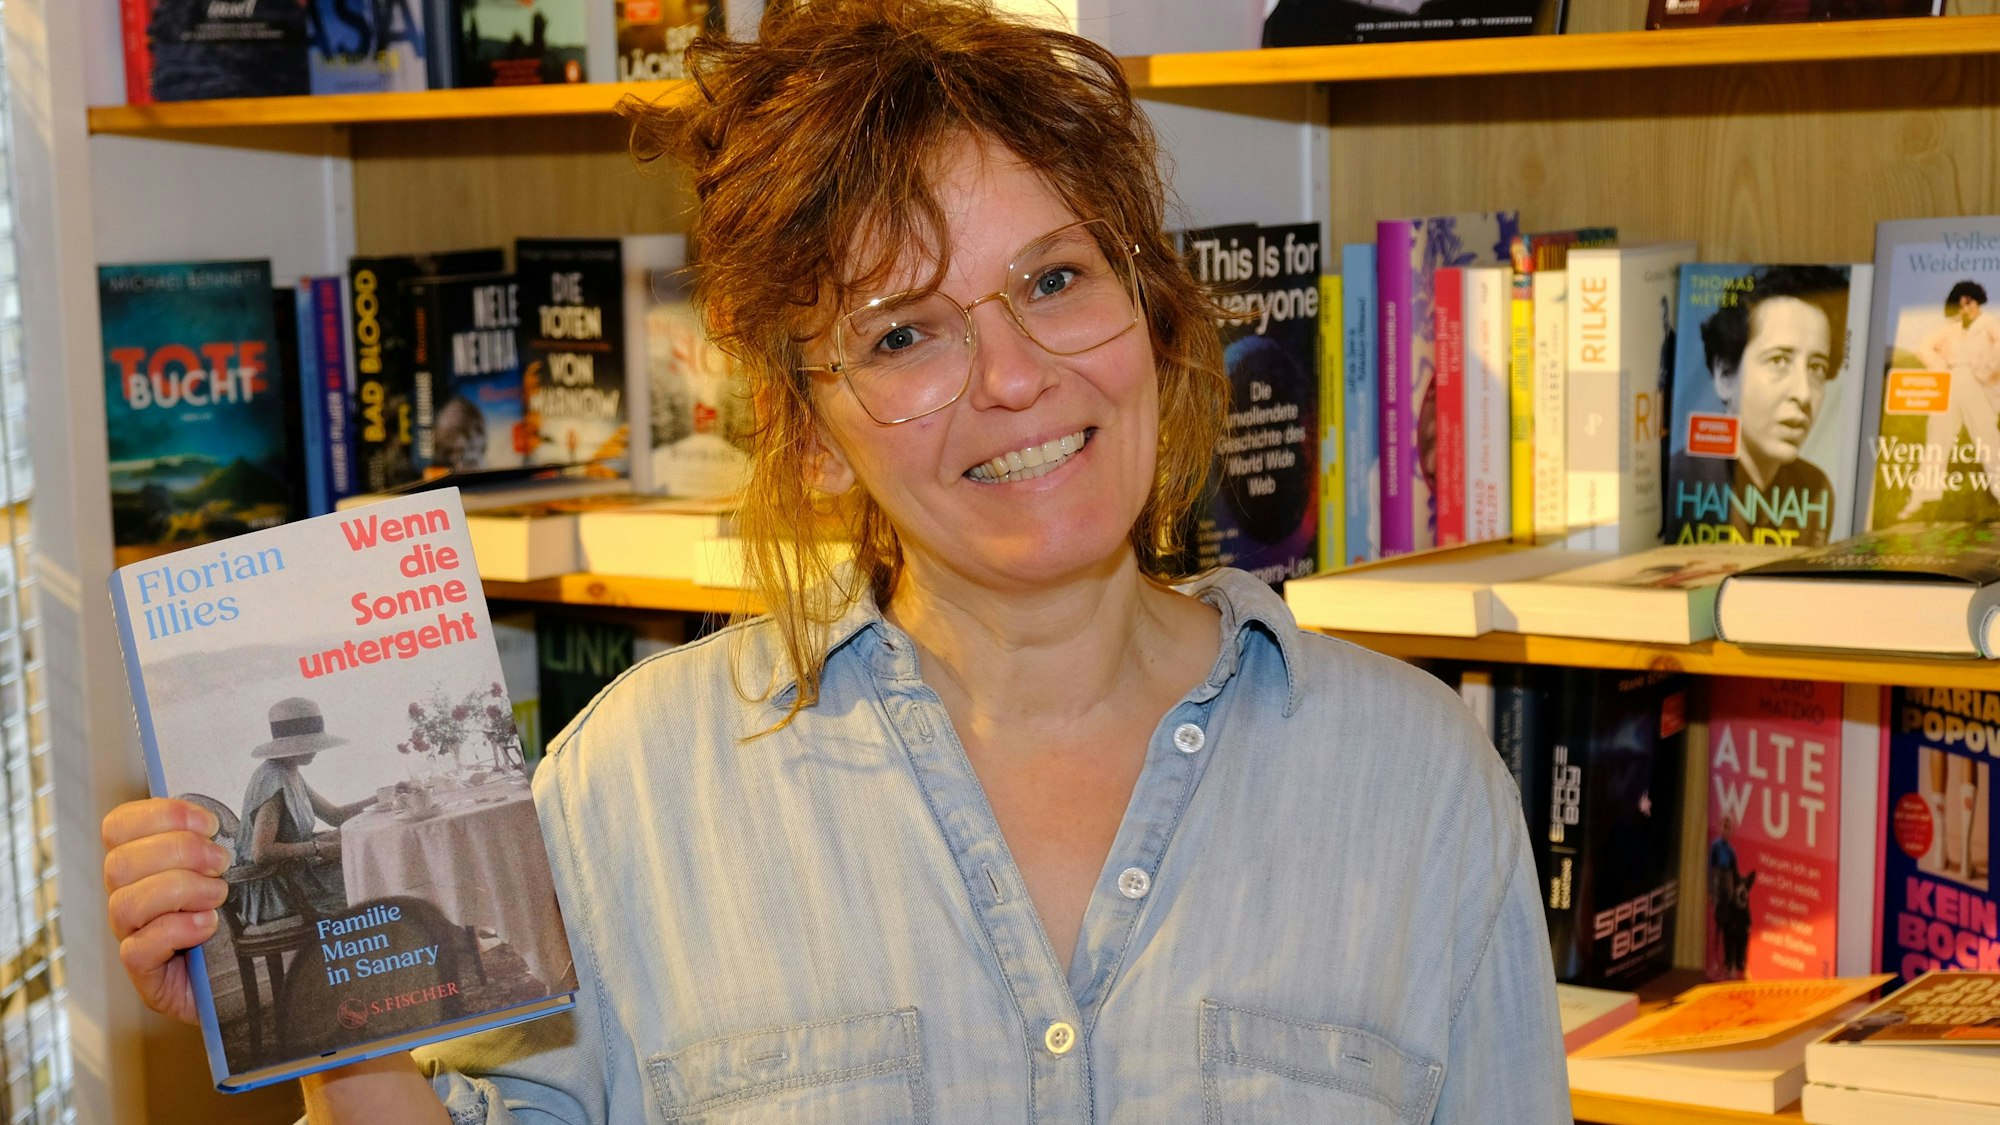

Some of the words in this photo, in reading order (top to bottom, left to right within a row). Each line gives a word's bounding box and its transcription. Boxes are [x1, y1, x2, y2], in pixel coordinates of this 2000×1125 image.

[1194, 238, 1254, 282] This
[1257, 236, 1281, 279] Is
[1284, 232, 1319, 275] for
[110, 274, 185, 291] MICHAEL
[188, 269, 262, 289] BENNETT
[552, 272, 583, 304] DIE
[1690, 275, 1755, 292] THOMAS
[1690, 292, 1738, 308] MEYER
[355, 269, 383, 374] BLOOD
[473, 284, 519, 328] NELE
[539, 305, 602, 339] TOTEN
[1208, 286, 1319, 335] veryone
[1581, 277, 1607, 363] RILKE
[110, 341, 268, 399] TOTE
[129, 367, 257, 410] BUCHT
[547, 353, 594, 387] VON
[1250, 381, 1272, 401] Die
[361, 381, 386, 443] BAD
[527, 389, 620, 421] WARNOW
[1228, 452, 1264, 477] World
[1265, 449, 1296, 471] Wide
[1870, 435, 1946, 464] Wenn
[1951, 436, 1992, 464] ich
[1247, 476, 1276, 498] Web
[1881, 461, 1963, 492] Wolke
[1675, 479, 1828, 529] HANNAH
[340, 508, 451, 551] Wenn
[136, 548, 285, 603] Florian
[399, 544, 459, 578] die
[144, 592, 240, 640] Illies
[351, 580, 468, 626] Sonne
[298, 610, 478, 678] untergeht
[543, 622, 631, 676] LINK
[1713, 724, 1825, 793] ALTE
[1714, 774, 1825, 848] WUT
[315, 904, 401, 940] Familie
[1594, 880, 1678, 940] SPACE
[1906, 876, 1997, 938] KEIN
[320, 930, 389, 962] Mann
[1611, 914, 1664, 960] BOY
[1898, 912, 2000, 970] BOCK
[326, 964, 351, 986] in
[356, 944, 439, 977] Sanary
